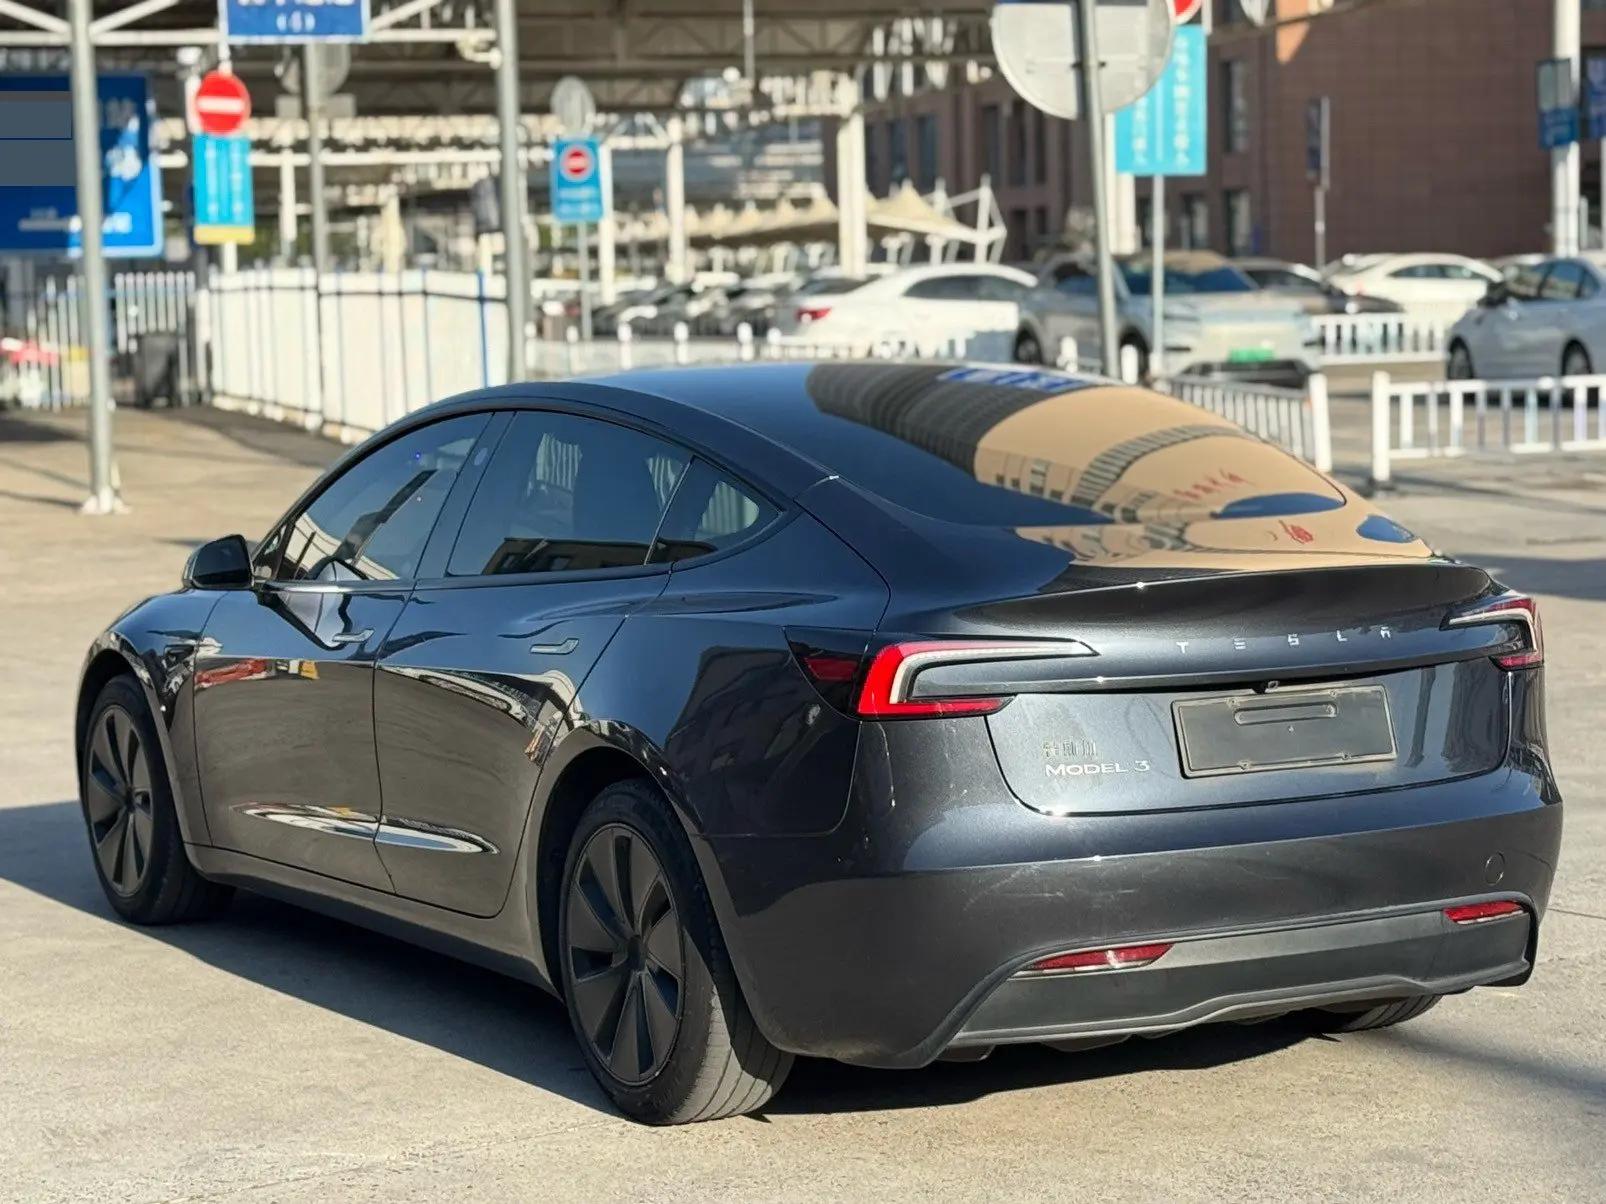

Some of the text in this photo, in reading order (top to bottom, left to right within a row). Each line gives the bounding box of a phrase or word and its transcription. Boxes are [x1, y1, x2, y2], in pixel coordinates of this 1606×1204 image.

[1176, 626, 1392, 654] TESLA
[1044, 760, 1151, 777] MODEL 3
